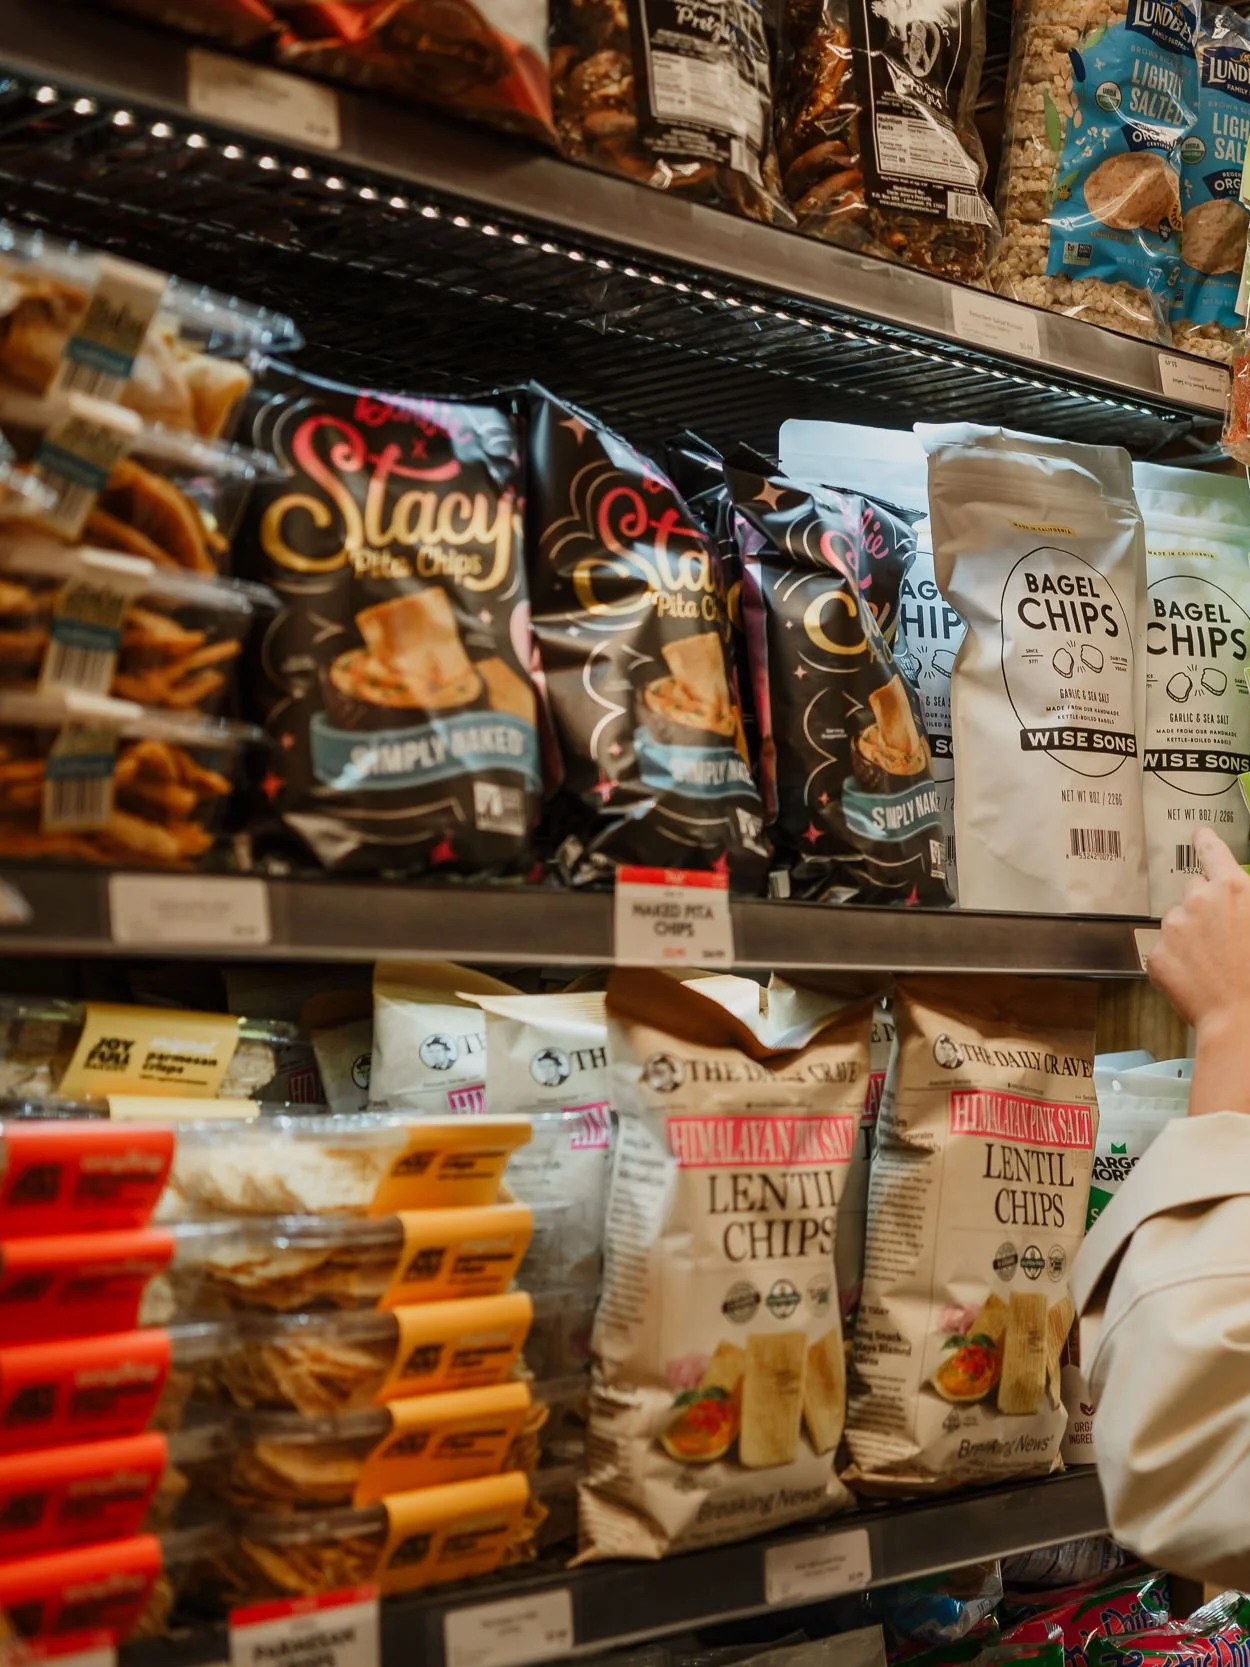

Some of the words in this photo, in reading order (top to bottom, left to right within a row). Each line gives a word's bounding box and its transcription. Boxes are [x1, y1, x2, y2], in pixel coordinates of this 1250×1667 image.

[1132, 0, 1195, 45] LUNDBE
[1152, 28, 1168, 41] FAMILY
[1131, 58, 1184, 102] LIGHTLY
[1227, 83, 1248, 96] FAMILY
[1130, 87, 1184, 126] SALTED
[1212, 112, 1250, 143] LIGH
[1214, 137, 1247, 164] SAL
[260, 414, 523, 592] Stacy
[1037, 526, 1072, 535] CALIFORNIA
[1177, 551, 1214, 559] CALIFORNIA
[1024, 572, 1100, 598] BAGEL
[654, 590, 699, 618] Pita
[1153, 598, 1231, 623] BAGEL
[901, 603, 962, 639] HIP
[1017, 597, 1119, 638] CHIPS
[1147, 622, 1247, 661] CHIPS
[933, 695, 946, 707] SEA
[1060, 688, 1080, 700] GARLIC
[1082, 690, 1087, 700] &
[1087, 691, 1097, 701] SEA
[1099, 692, 1110, 704] SALT
[1169, 713, 1194, 723] GARLIC
[1196, 713, 1201, 723] &
[1203, 713, 1215, 724] SEA
[1216, 714, 1229, 725] SALT
[451, 726, 525, 758] NAKED
[1027, 730, 1088, 748] WISE
[1092, 734, 1136, 753] SONS
[351, 735, 446, 775] SIMPLY
[1144, 753, 1199, 768] WISE
[1205, 754, 1250, 772] SONS
[1061, 789, 1074, 802] NET
[1076, 790, 1087, 802] WT
[1107, 793, 1123, 806] 226G
[871, 800, 916, 830] SIMPLY
[1167, 808, 1181, 820] NET
[1184, 809, 1196, 820] WT
[1219, 810, 1234, 823] 226G
[1183, 867, 1203, 875] 53242
[653, 921, 695, 938] CHIPS
[99, 1036, 135, 1050] JOY
[142, 1063, 184, 1075] crisps
[146, 1052, 218, 1067] parmesan
[569, 1046, 608, 1072] TH
[685, 1058, 741, 1083] THE
[807, 1060, 859, 1083] CRAVE
[960, 1043, 995, 1067] THE
[996, 1050, 1044, 1071] DAILY
[1044, 1054, 1092, 1078] CRAVE
[952, 1093, 1030, 1139] HIMALAYAN
[1030, 1106, 1059, 1143] PINK
[1057, 1107, 1091, 1145] SALT
[670, 1119, 793, 1164] HIMALAYAN
[794, 1119, 822, 1161] PINK
[821, 1118, 854, 1162] SALT
[982, 1143, 1075, 1187] LENTIL
[708, 1170, 839, 1215] LENTIL
[995, 1187, 1065, 1228] CHIPS
[723, 1216, 836, 1262] CHIPS
[958, 1438, 1014, 1459] Breaking
[1015, 1434, 1050, 1453] News
